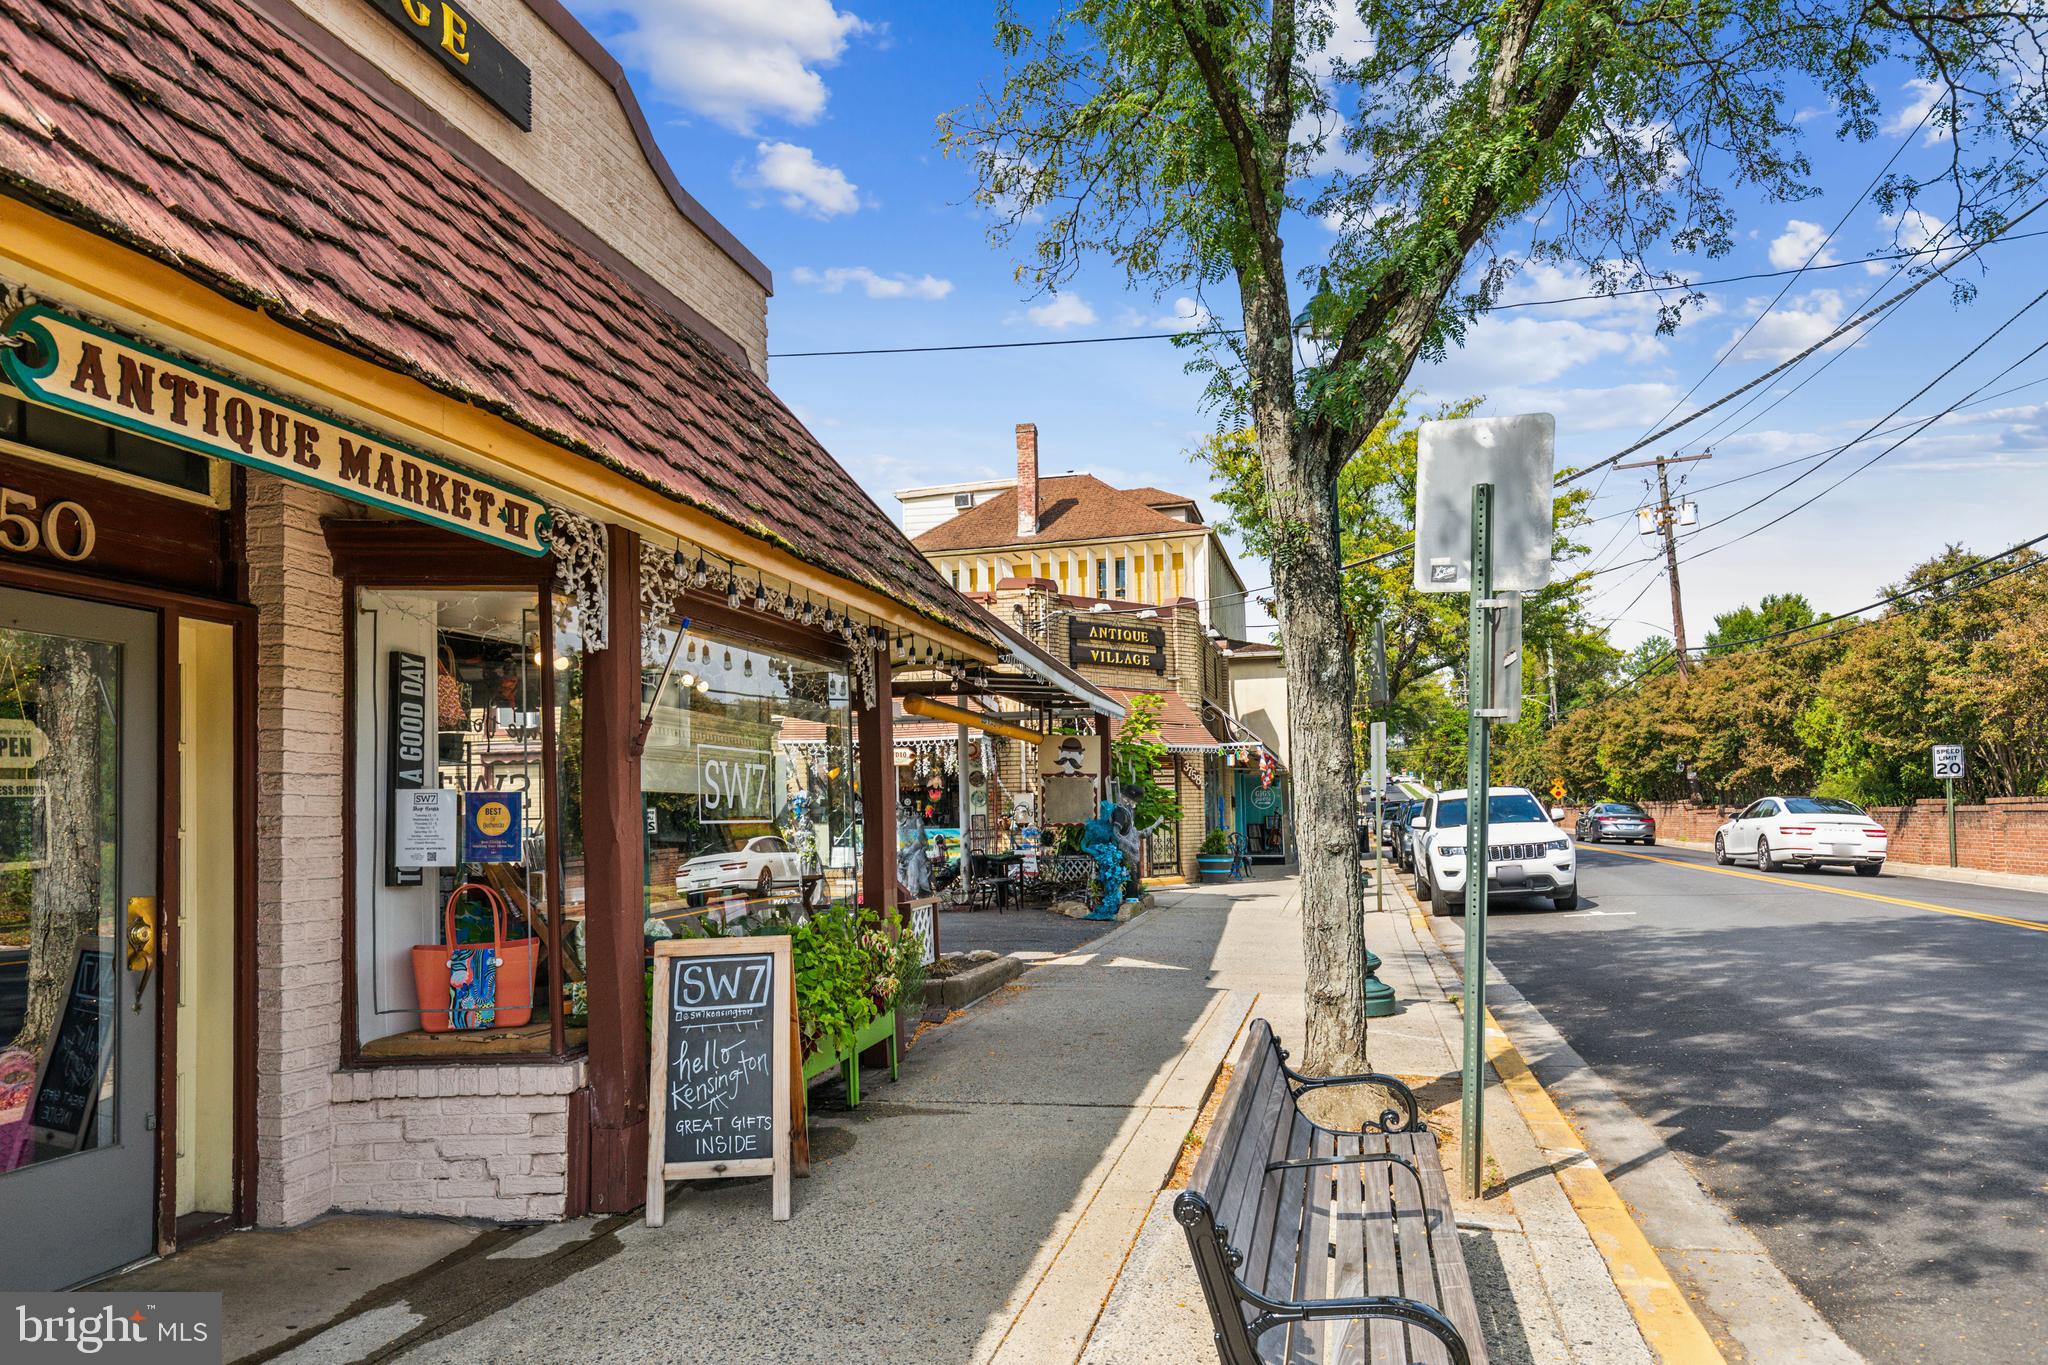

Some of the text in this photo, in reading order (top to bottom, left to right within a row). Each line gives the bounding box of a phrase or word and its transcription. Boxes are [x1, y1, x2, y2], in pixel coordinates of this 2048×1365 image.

[70, 341, 321, 471] ANTIQUE
[338, 436, 496, 528] MARKET
[0, 487, 95, 561] 50
[1089, 626, 1149, 643] ANTIQUE
[1090, 650, 1151, 666] VILLAGE
[399, 655, 426, 784] A GOOD DAY
[1183, 760, 1201, 785] 3758
[1937, 763, 1960, 774] 20
[16, 785, 46, 795] HOURS
[704, 759, 767, 809] SW7
[416, 795, 436, 803] SW7
[683, 965, 766, 1004] SW7
[672, 1040, 746, 1081] hello
[671, 1052, 769, 1111] Kensington
[676, 1115, 772, 1133] GREAT GIFTS
[696, 1134, 757, 1154] INSIDE
